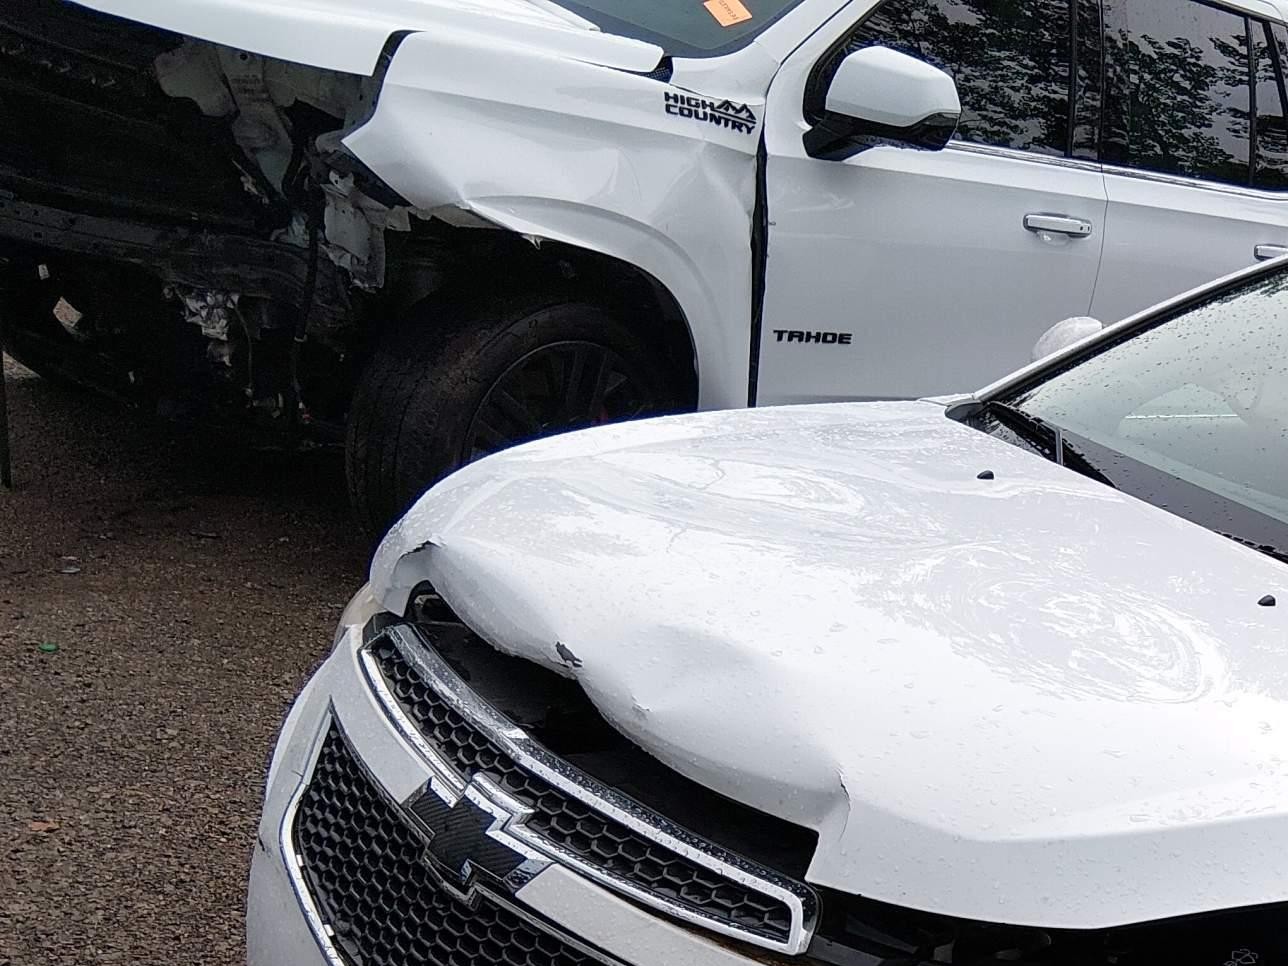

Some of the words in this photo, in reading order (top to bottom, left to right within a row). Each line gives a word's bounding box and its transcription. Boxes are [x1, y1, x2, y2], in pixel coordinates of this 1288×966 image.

[664, 91, 715, 111] HIGH
[665, 103, 755, 134] COUNTRY
[773, 330, 853, 344] TAHOE
